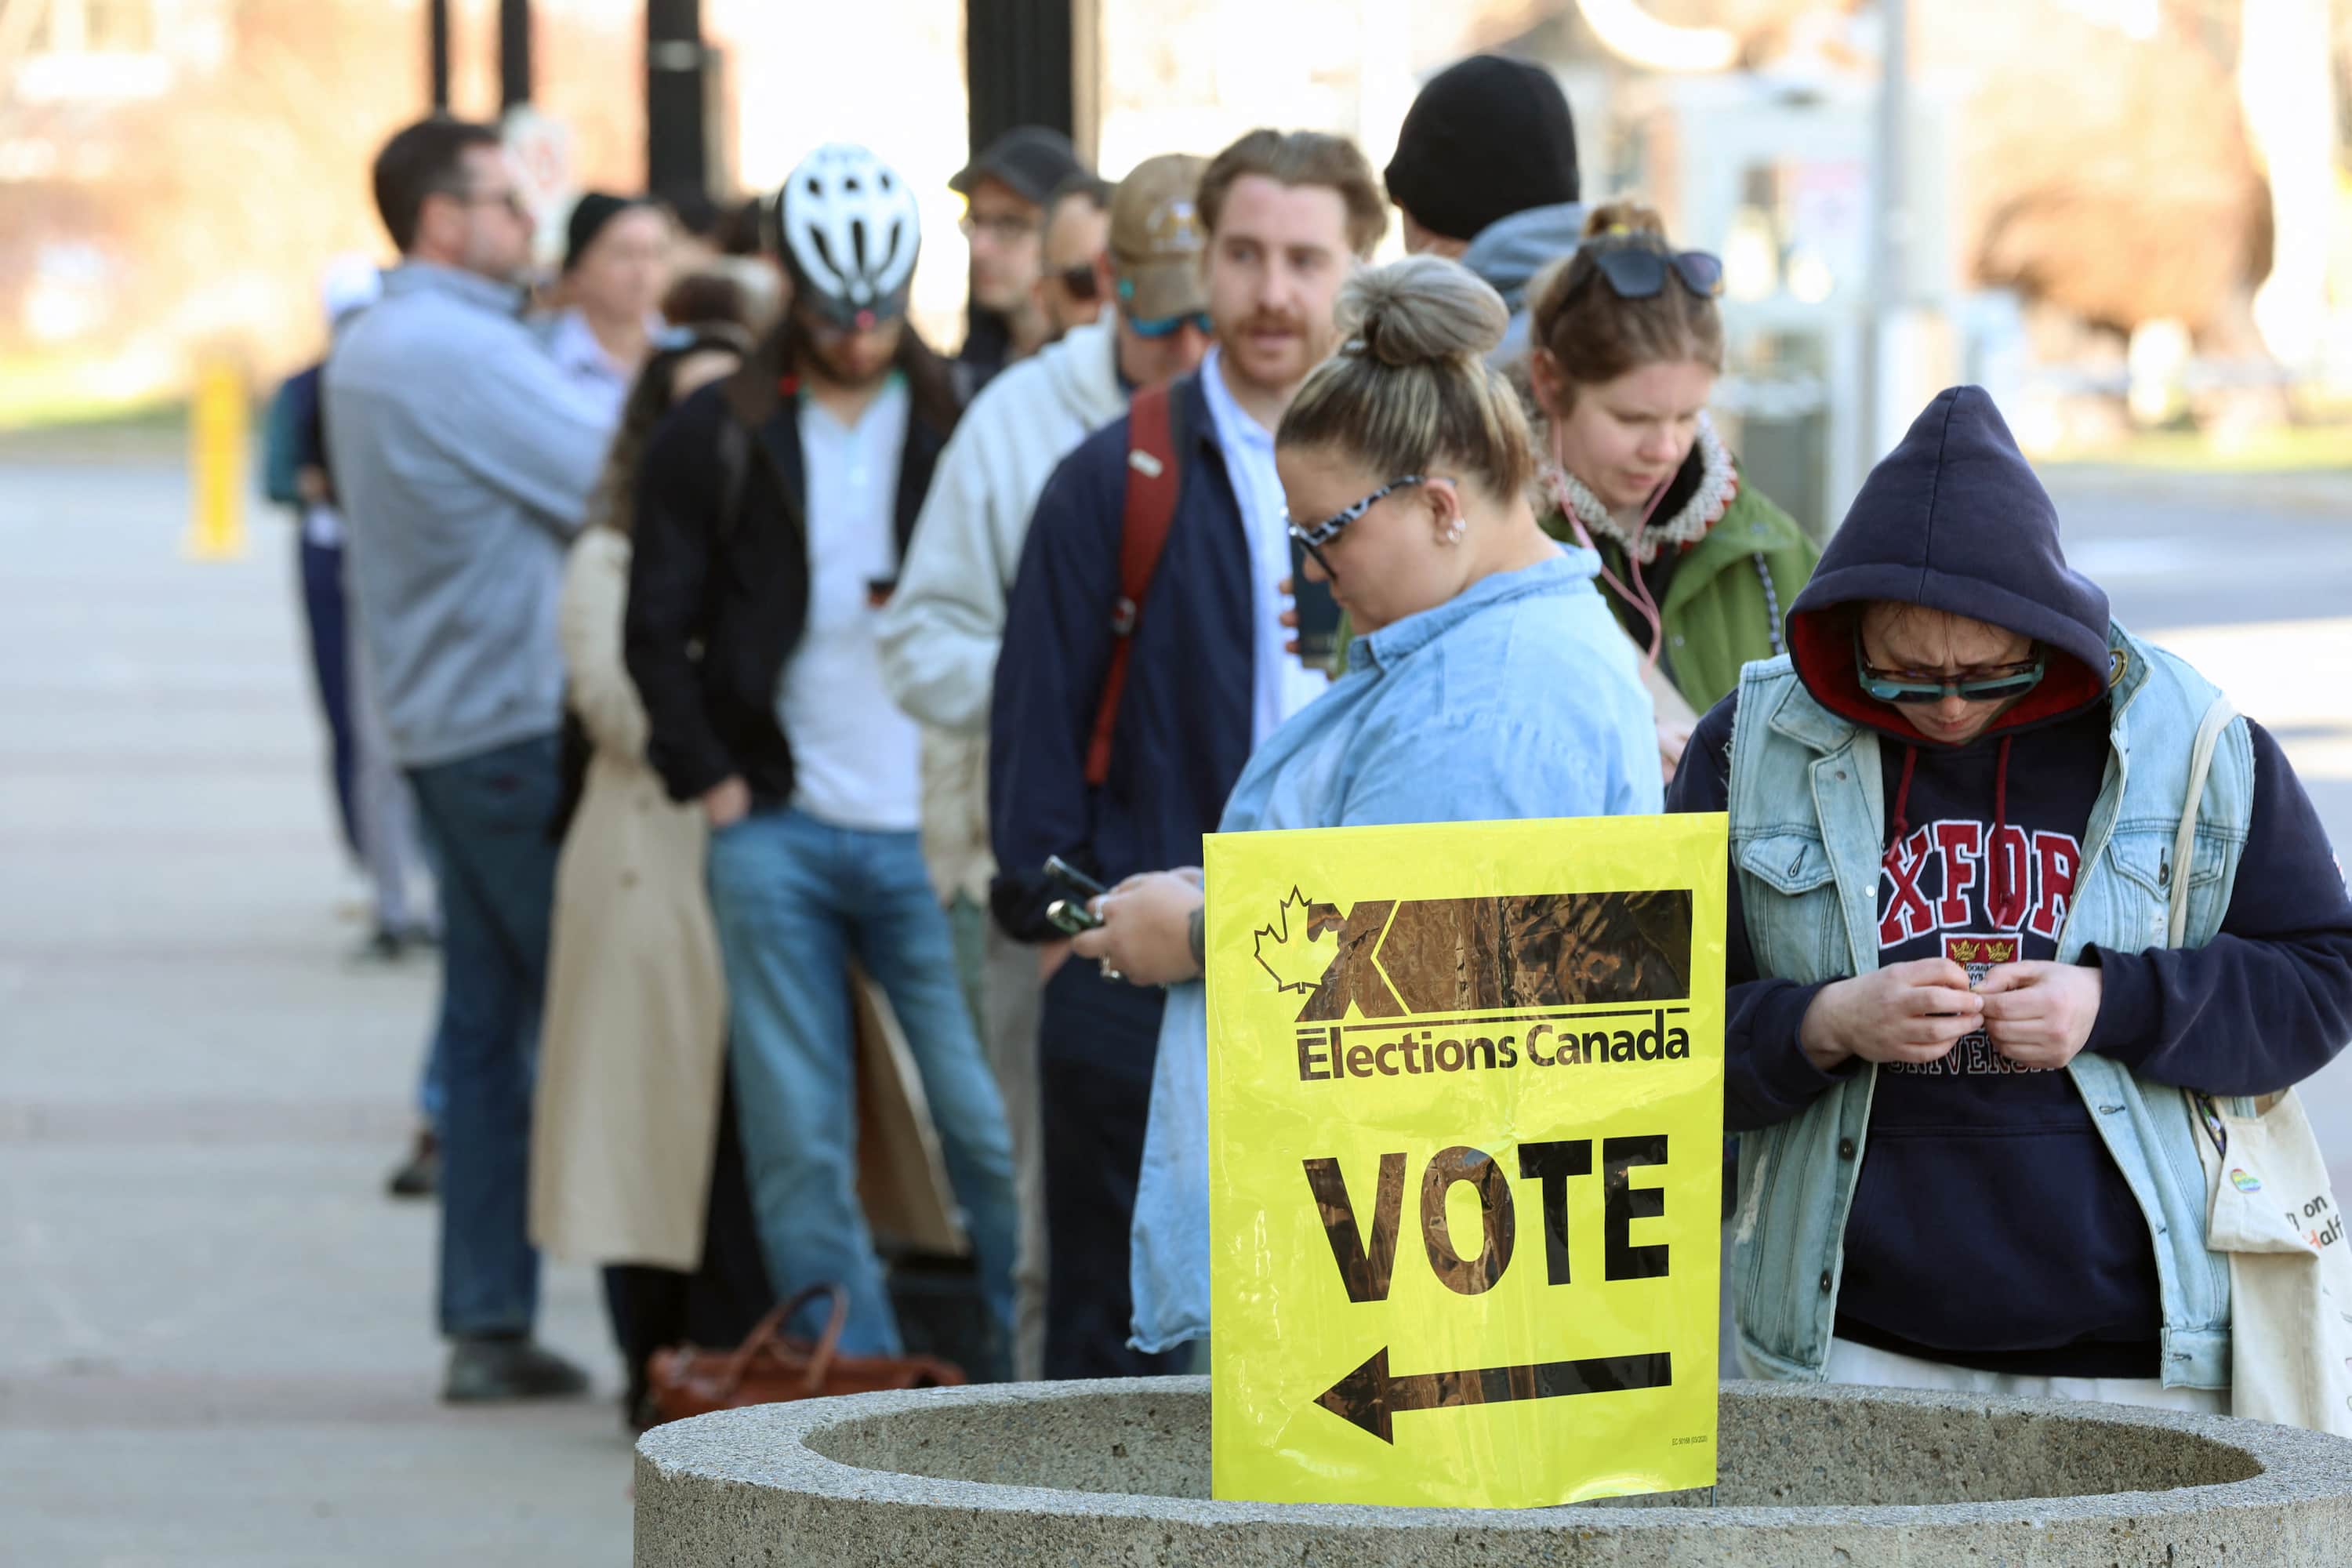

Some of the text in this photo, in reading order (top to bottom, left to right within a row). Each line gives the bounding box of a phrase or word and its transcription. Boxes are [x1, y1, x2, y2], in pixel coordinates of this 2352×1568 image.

[1878, 819, 2082, 949] XFOR
[1296, 1009, 1690, 1081] Elections Canada
[1301, 1134, 1670, 1304] VOTE
[2303, 1196, 2328, 1218] on
